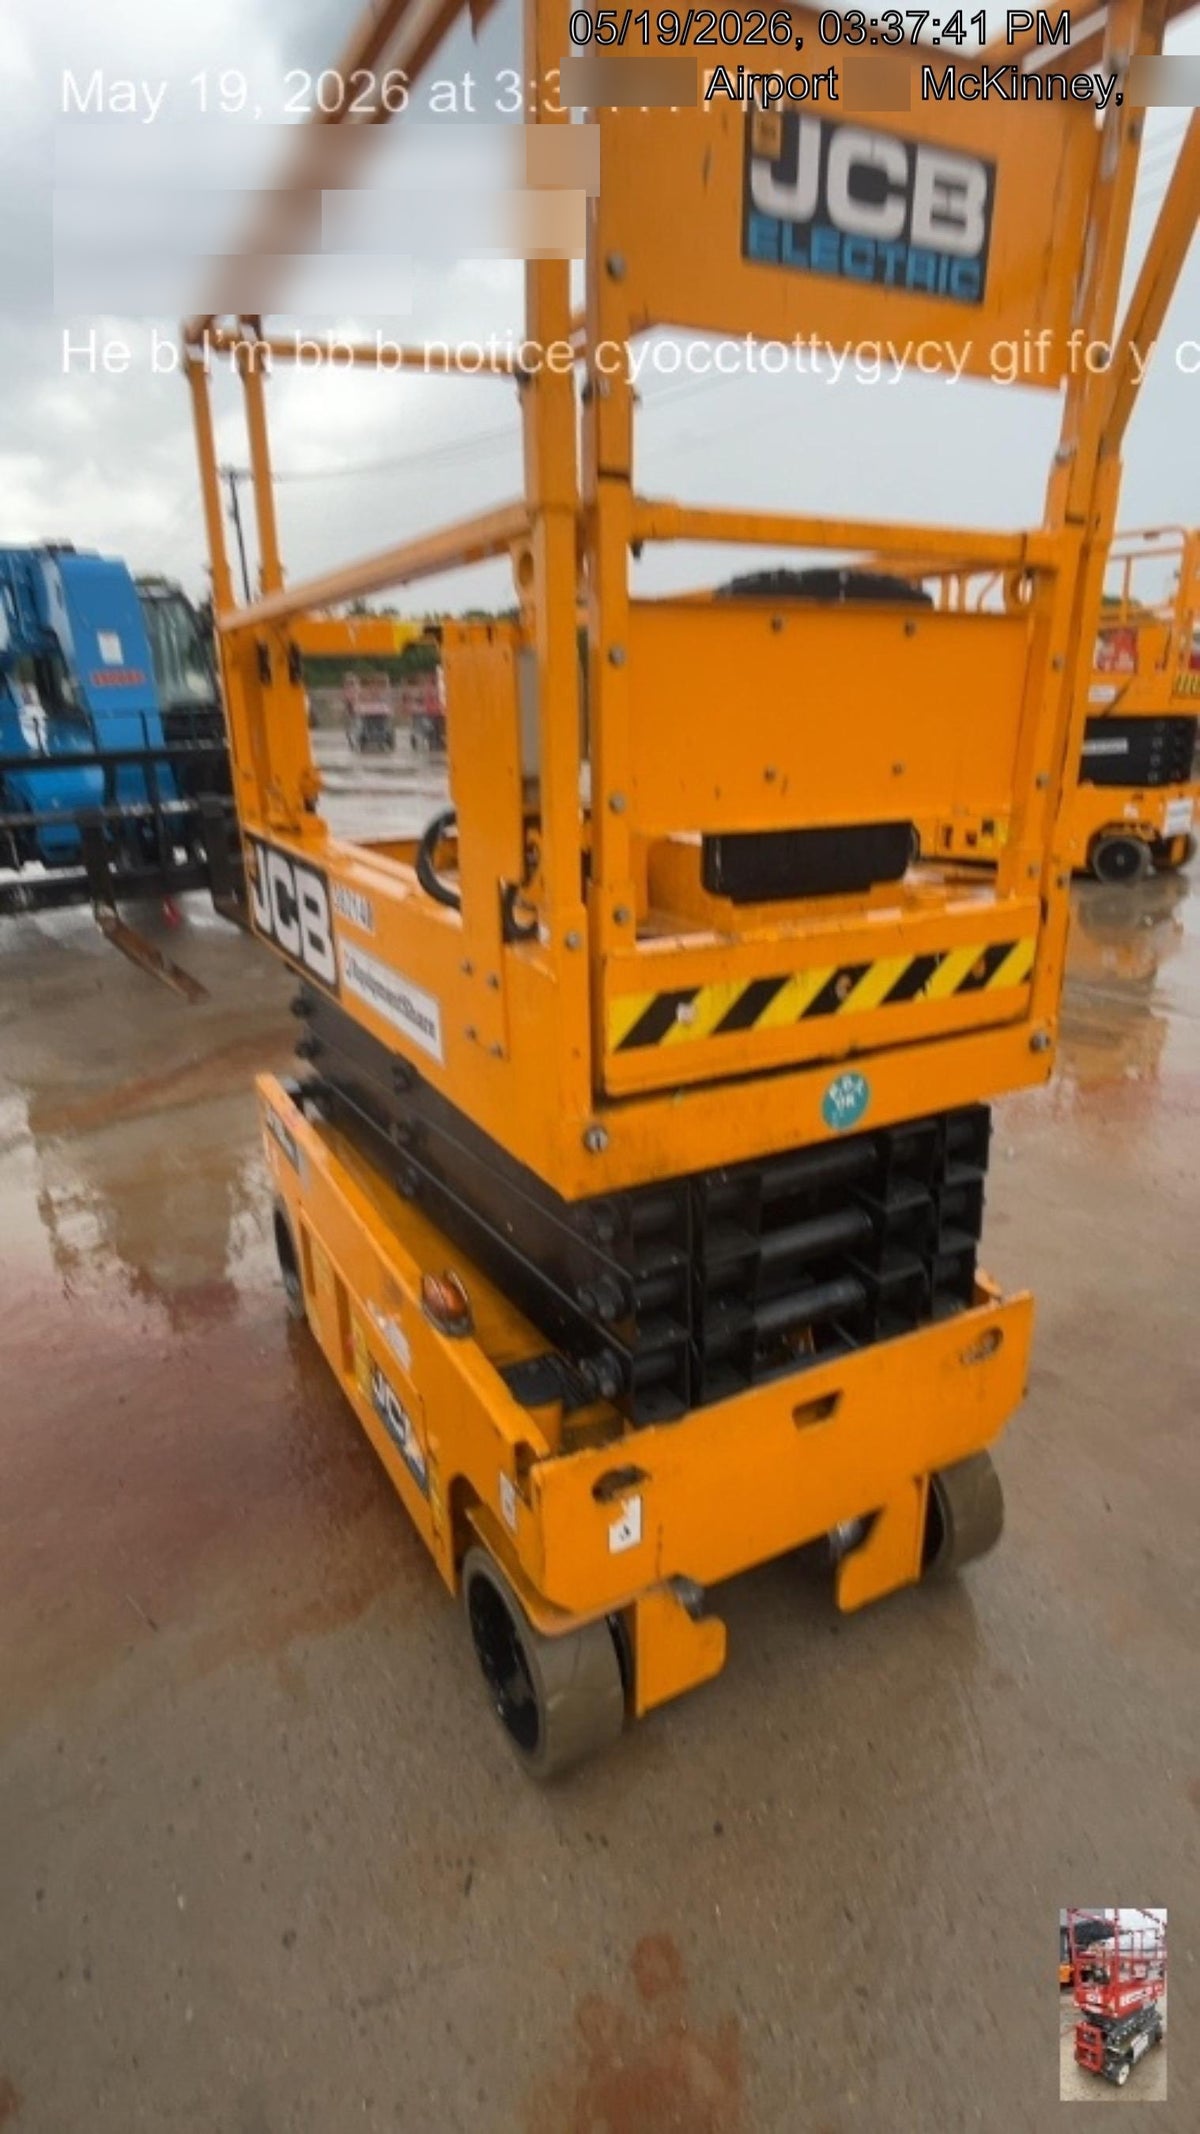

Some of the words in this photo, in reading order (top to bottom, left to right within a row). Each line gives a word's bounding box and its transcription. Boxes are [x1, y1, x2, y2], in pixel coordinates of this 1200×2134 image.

[747, 212, 982, 301] ELECTRIC
[751, 114, 988, 258] JCB
[251, 843, 336, 986] JCB
